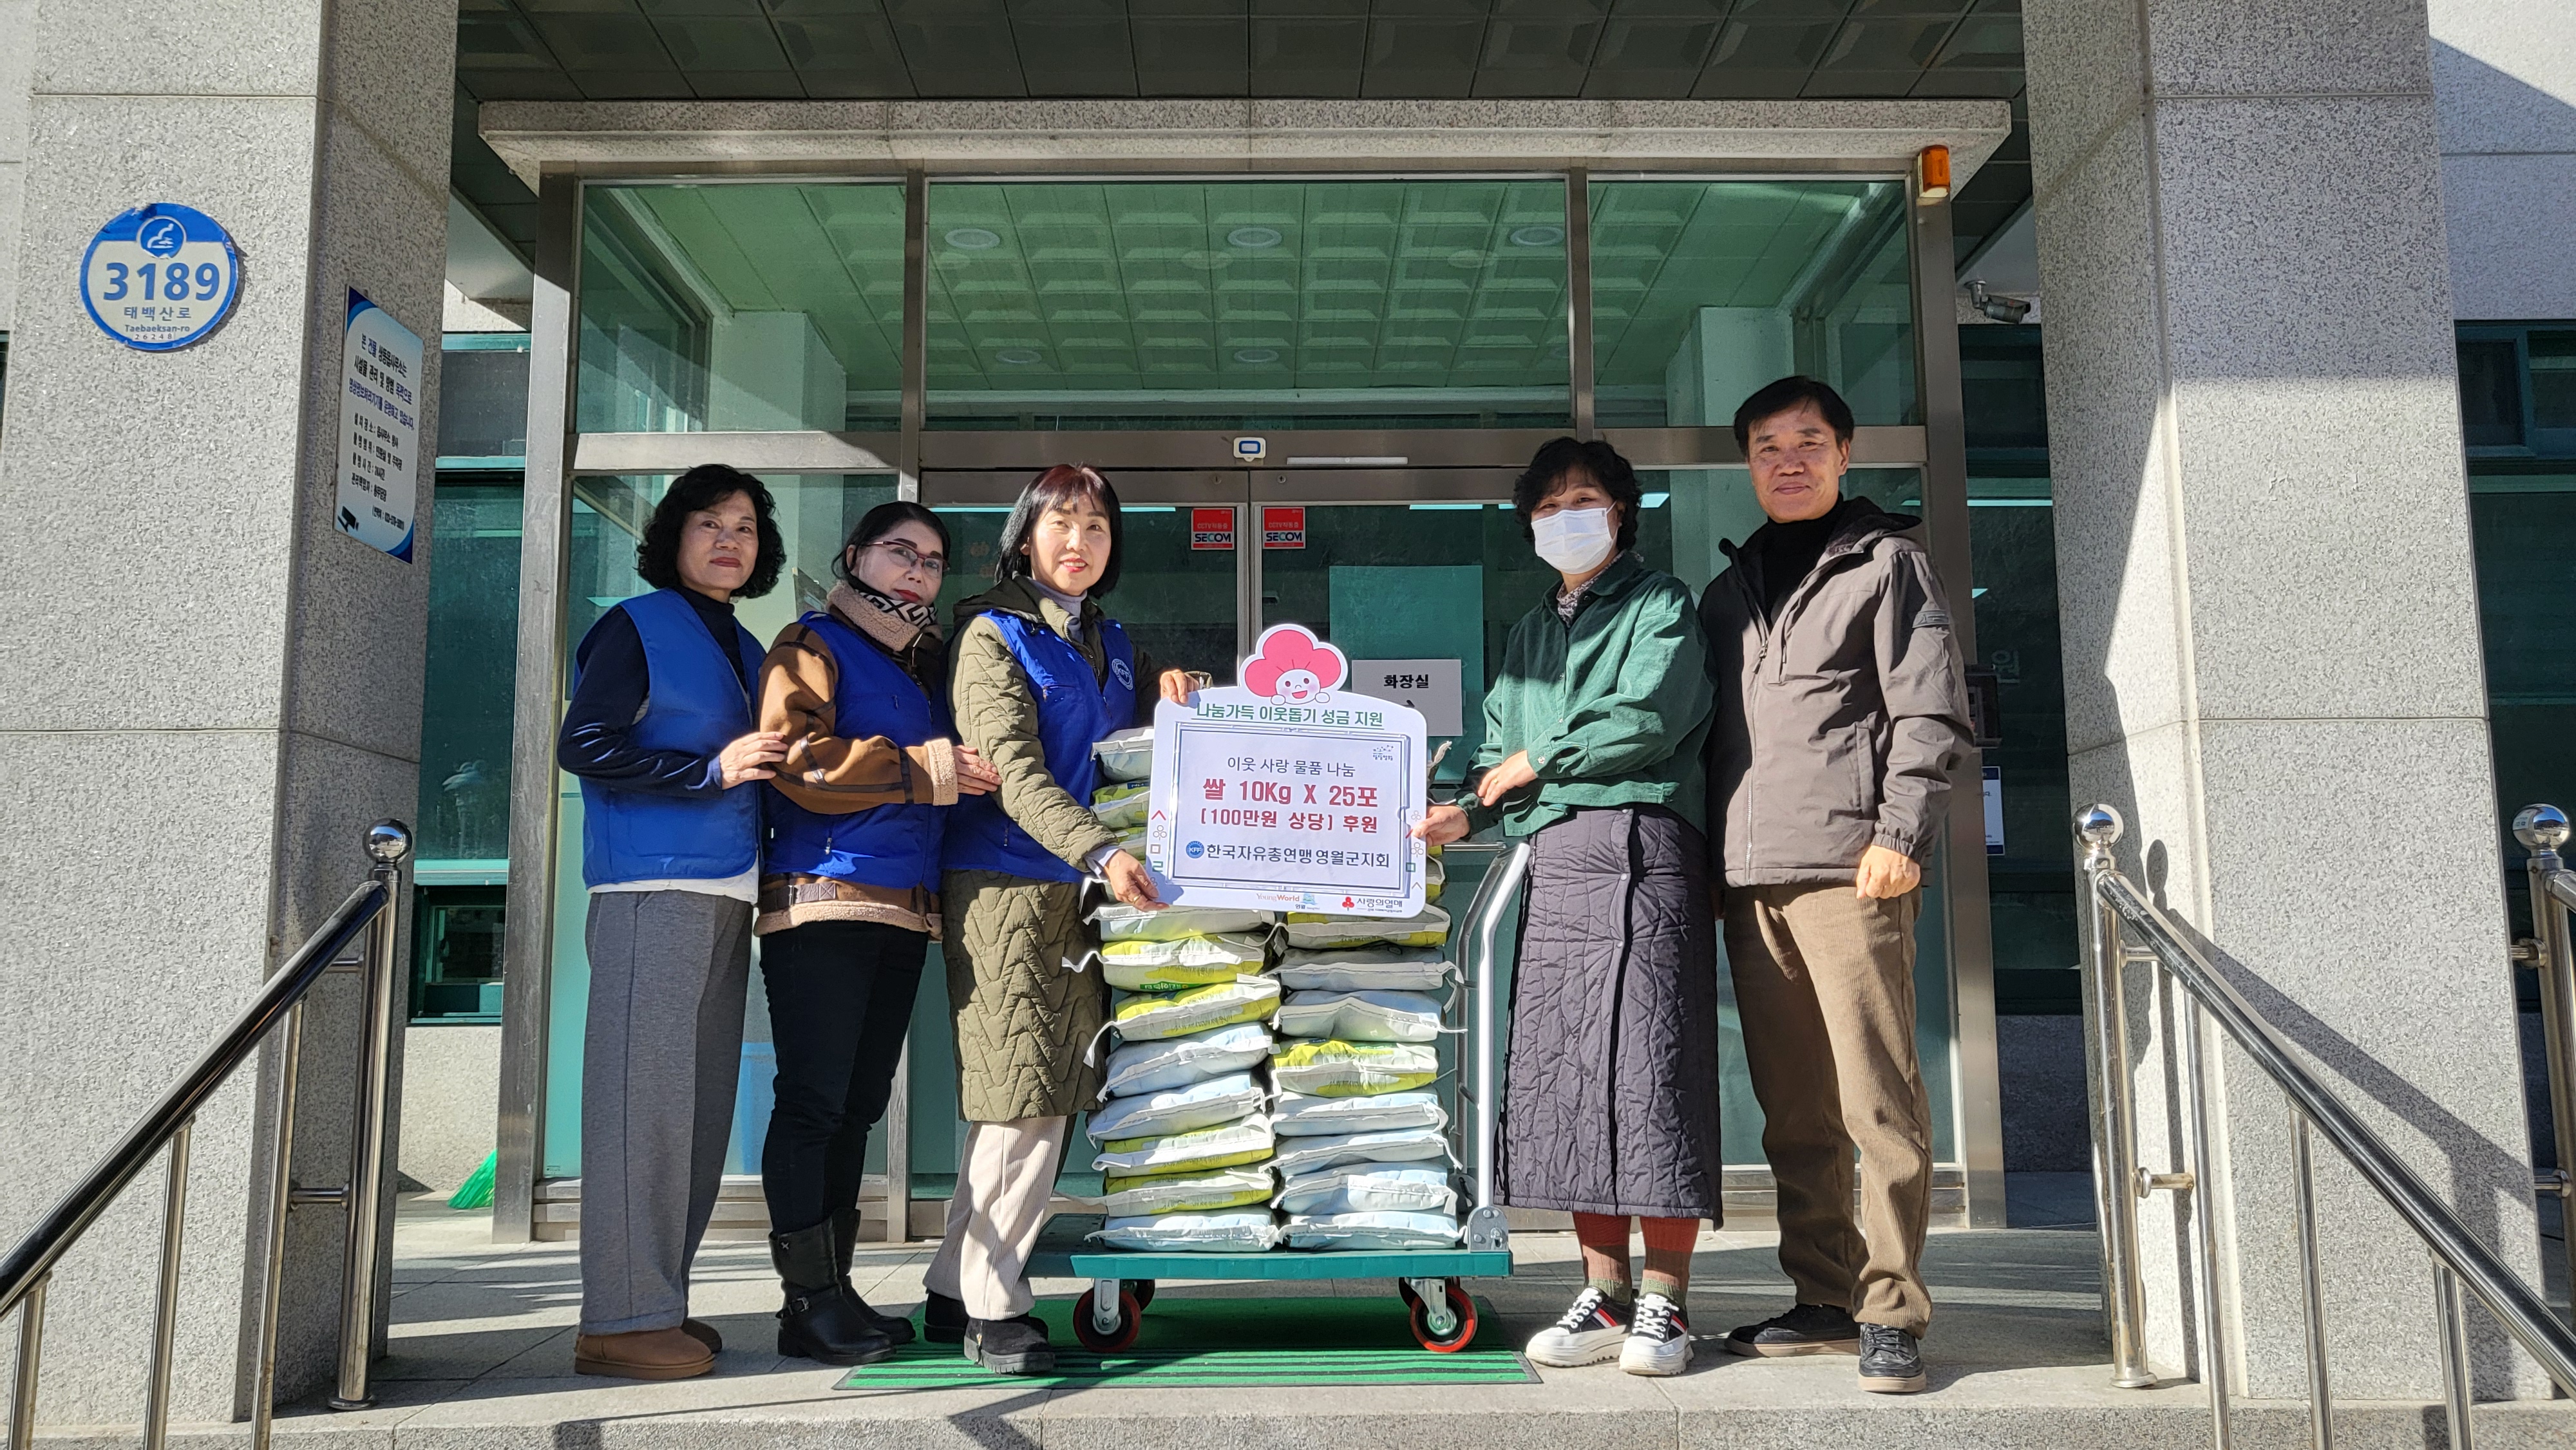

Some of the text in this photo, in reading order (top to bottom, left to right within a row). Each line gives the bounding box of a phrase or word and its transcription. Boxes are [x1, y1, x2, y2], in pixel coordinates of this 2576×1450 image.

[103, 263, 220, 301] 3189
[124, 306, 191, 321] 태백산로
[368, 338, 377, 358] 건물
[379, 345, 407, 378] 상동읍사무소는
[354, 355, 412, 405] 시설물 관리 및 방범 목적으로
[349, 377, 383, 411] 영상정보처리기기를
[384, 400, 399, 420] 운영하고
[1195, 533, 1231, 542] SECOM
[1266, 532, 1302, 541] SECOM
[1383, 674, 1429, 689] 화장실
[1197, 702, 1383, 727] 나눔가득 이웃돕기 성금 지원
[1227, 757, 1356, 777] 이웃 사랑 물품 나눔
[1203, 778, 1378, 807] 쌀 10Kg X 25포
[1343, 814, 1378, 833] 후원
[1357, 898, 1403, 909] 사랑의열매
